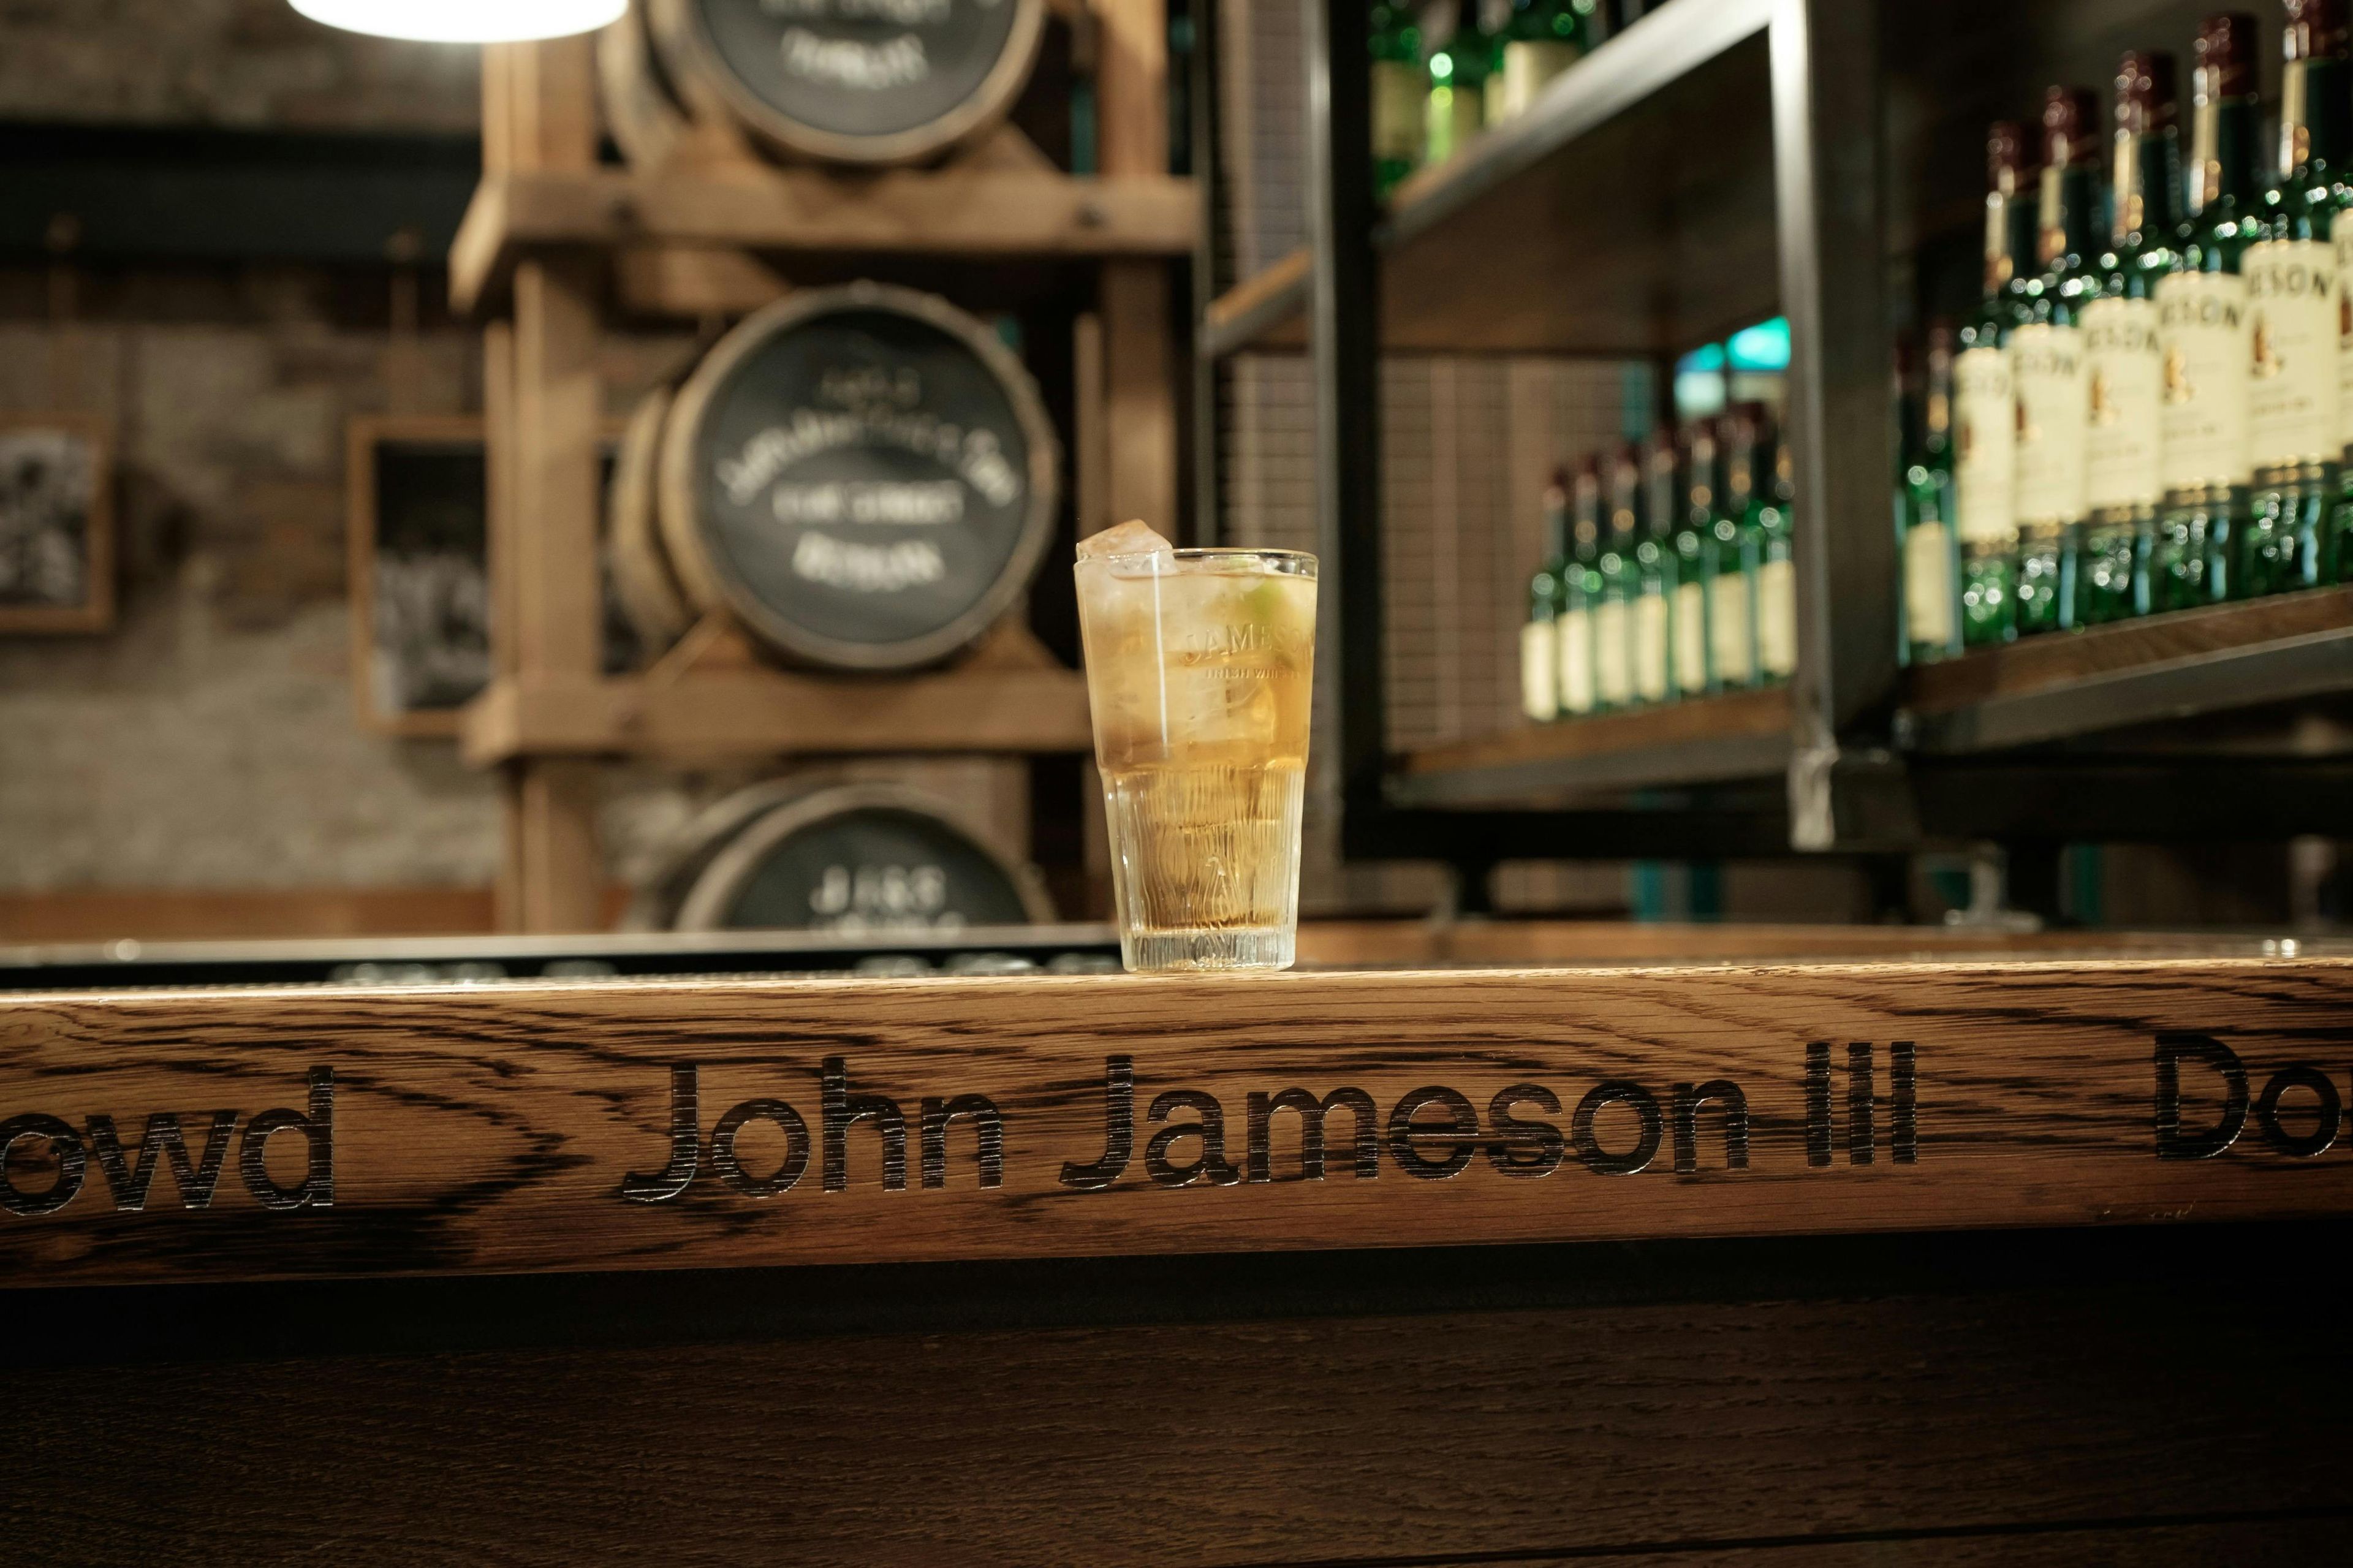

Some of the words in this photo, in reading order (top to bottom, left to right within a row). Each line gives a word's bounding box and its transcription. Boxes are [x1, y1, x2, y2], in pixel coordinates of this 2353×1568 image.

[0, 1066, 335, 1216] owd
[621, 1056, 1003, 1202] John
[1058, 1055, 1749, 1191] Jameson
[1806, 1041, 1917, 1167] III
[2154, 1033, 2353, 1160] Do
